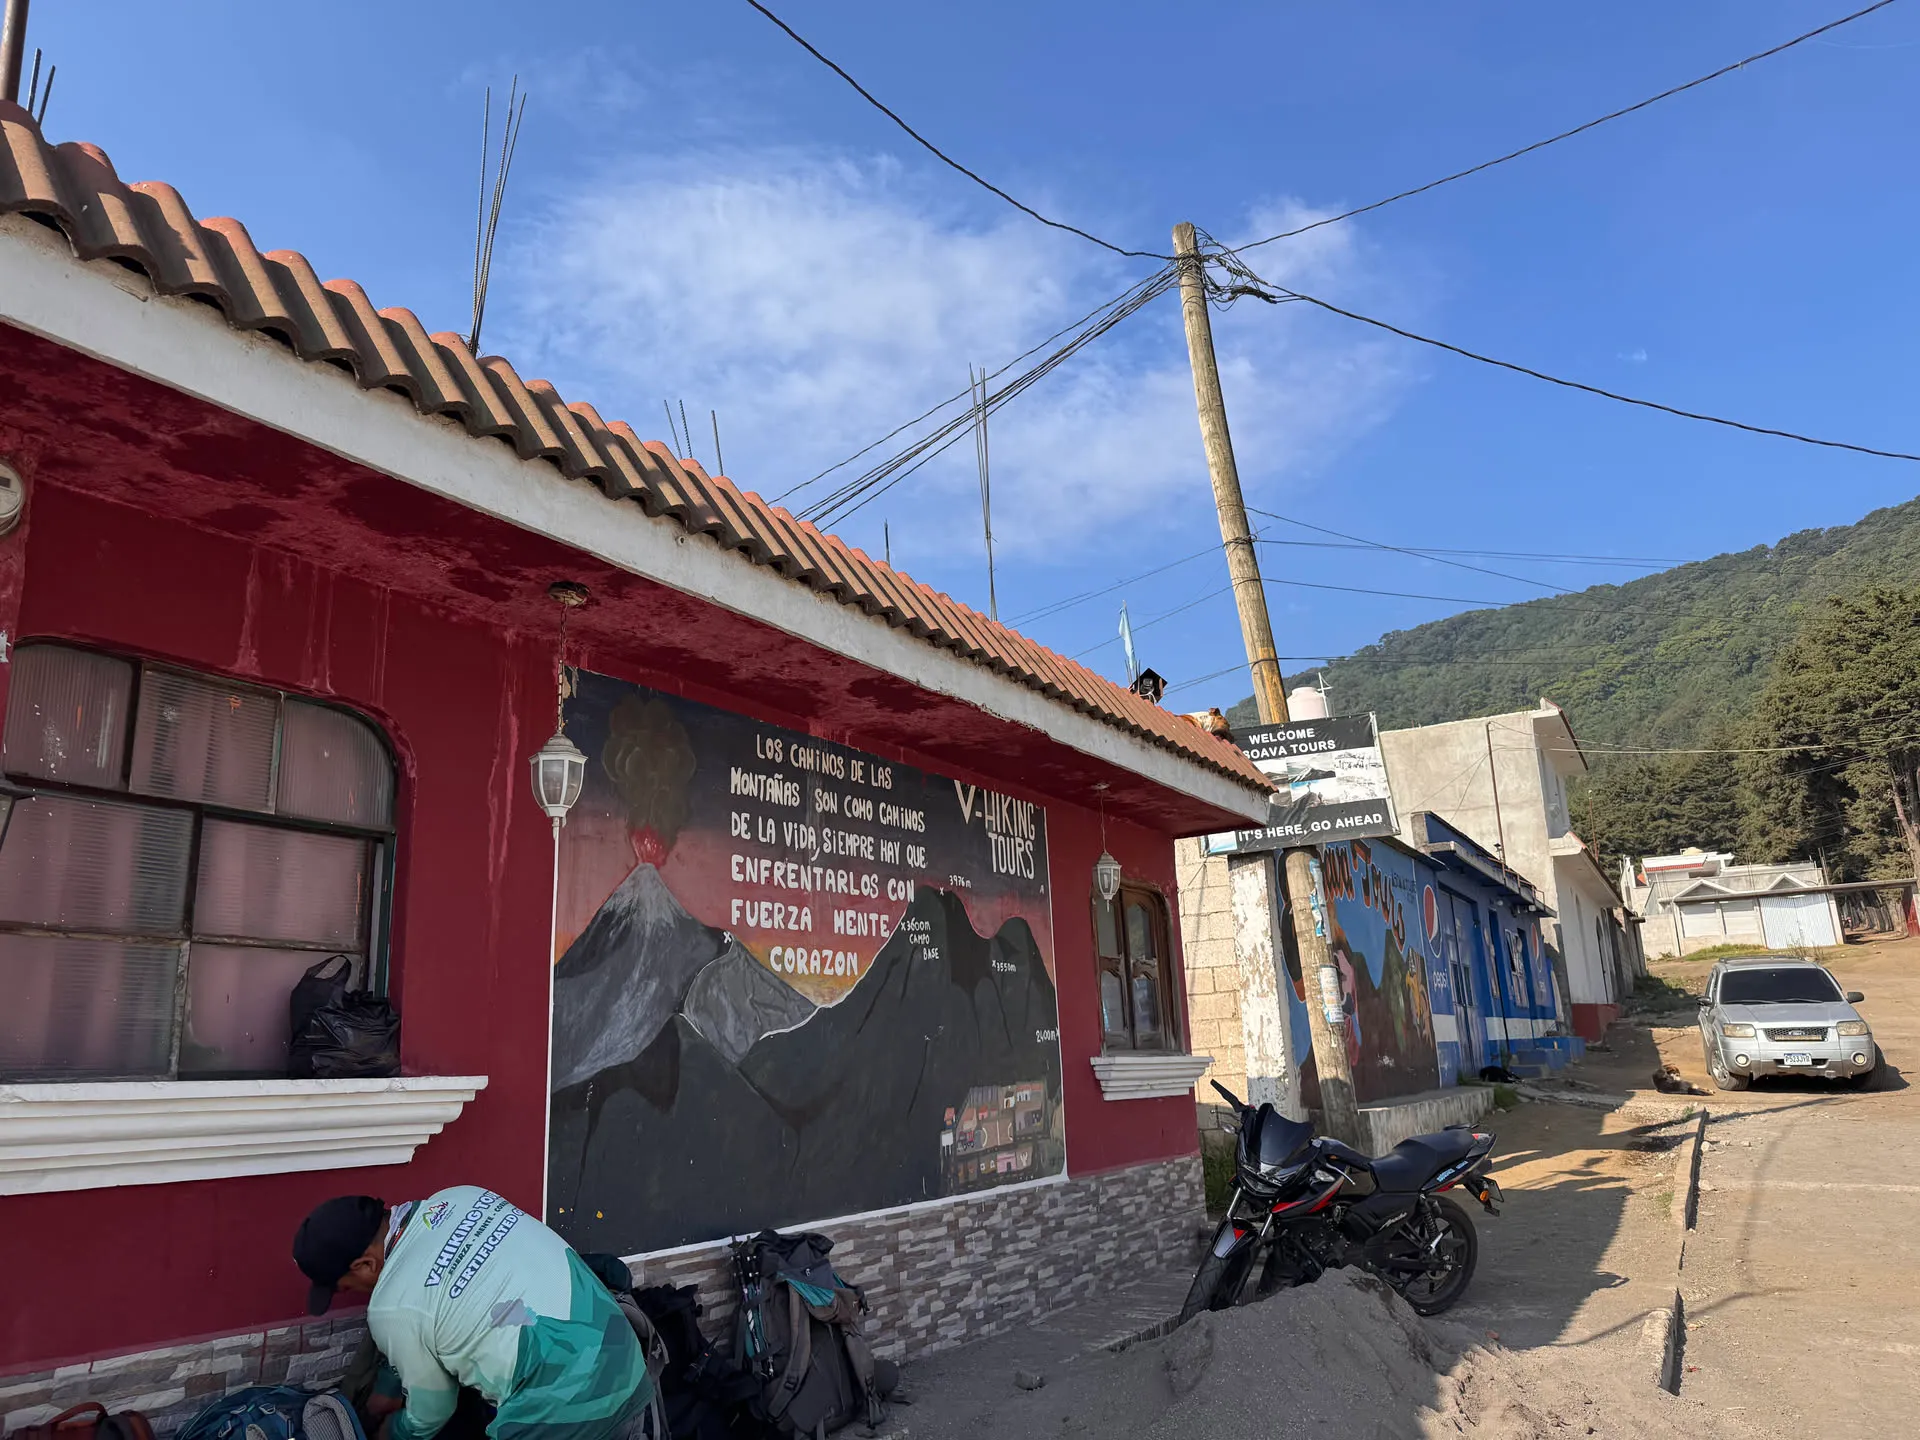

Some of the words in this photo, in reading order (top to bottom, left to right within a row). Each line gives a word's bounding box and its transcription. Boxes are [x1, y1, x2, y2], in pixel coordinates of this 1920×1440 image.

[1249, 728, 1315, 745] WELCOME
[1290, 740, 1336, 754] TOURS
[757, 734, 783, 763] LOS
[851, 760, 865, 783] DE
[871, 764, 892, 790] LAS
[731, 766, 800, 807] MONTAÑAS
[815, 788, 838, 814] SON
[844, 795, 873, 821] COMO
[954, 780, 1035, 840] V-HIKING
[731, 812, 751, 840] DE
[758, 816, 776, 844] LA
[881, 839, 900, 865] HAY
[906, 844, 926, 868] QUE
[1238, 829, 1263, 842] IT'S
[1266, 824, 1308, 839] HERE,
[1311, 820, 1331, 832] GO
[1335, 813, 1383, 829] AHEAD
[731, 854, 879, 899] ENFRENTARLOS
[887, 878, 915, 903] CON
[988, 832, 1034, 879] TOURS
[731, 899, 812, 932] FUERZA
[833, 909, 890, 938] MENTE
[909, 933, 930, 945] CAMPO
[769, 946, 859, 976] CORAZON
[923, 948, 939, 960] BASE
[1432, 967, 1448, 993] pepsi
[424, 1210, 483, 1287] V-HIKING
[448, 1243, 473, 1275] FUERZA
[474, 1216, 494, 1237] MENTE
[449, 1214, 518, 1299] CERTIFICATED
